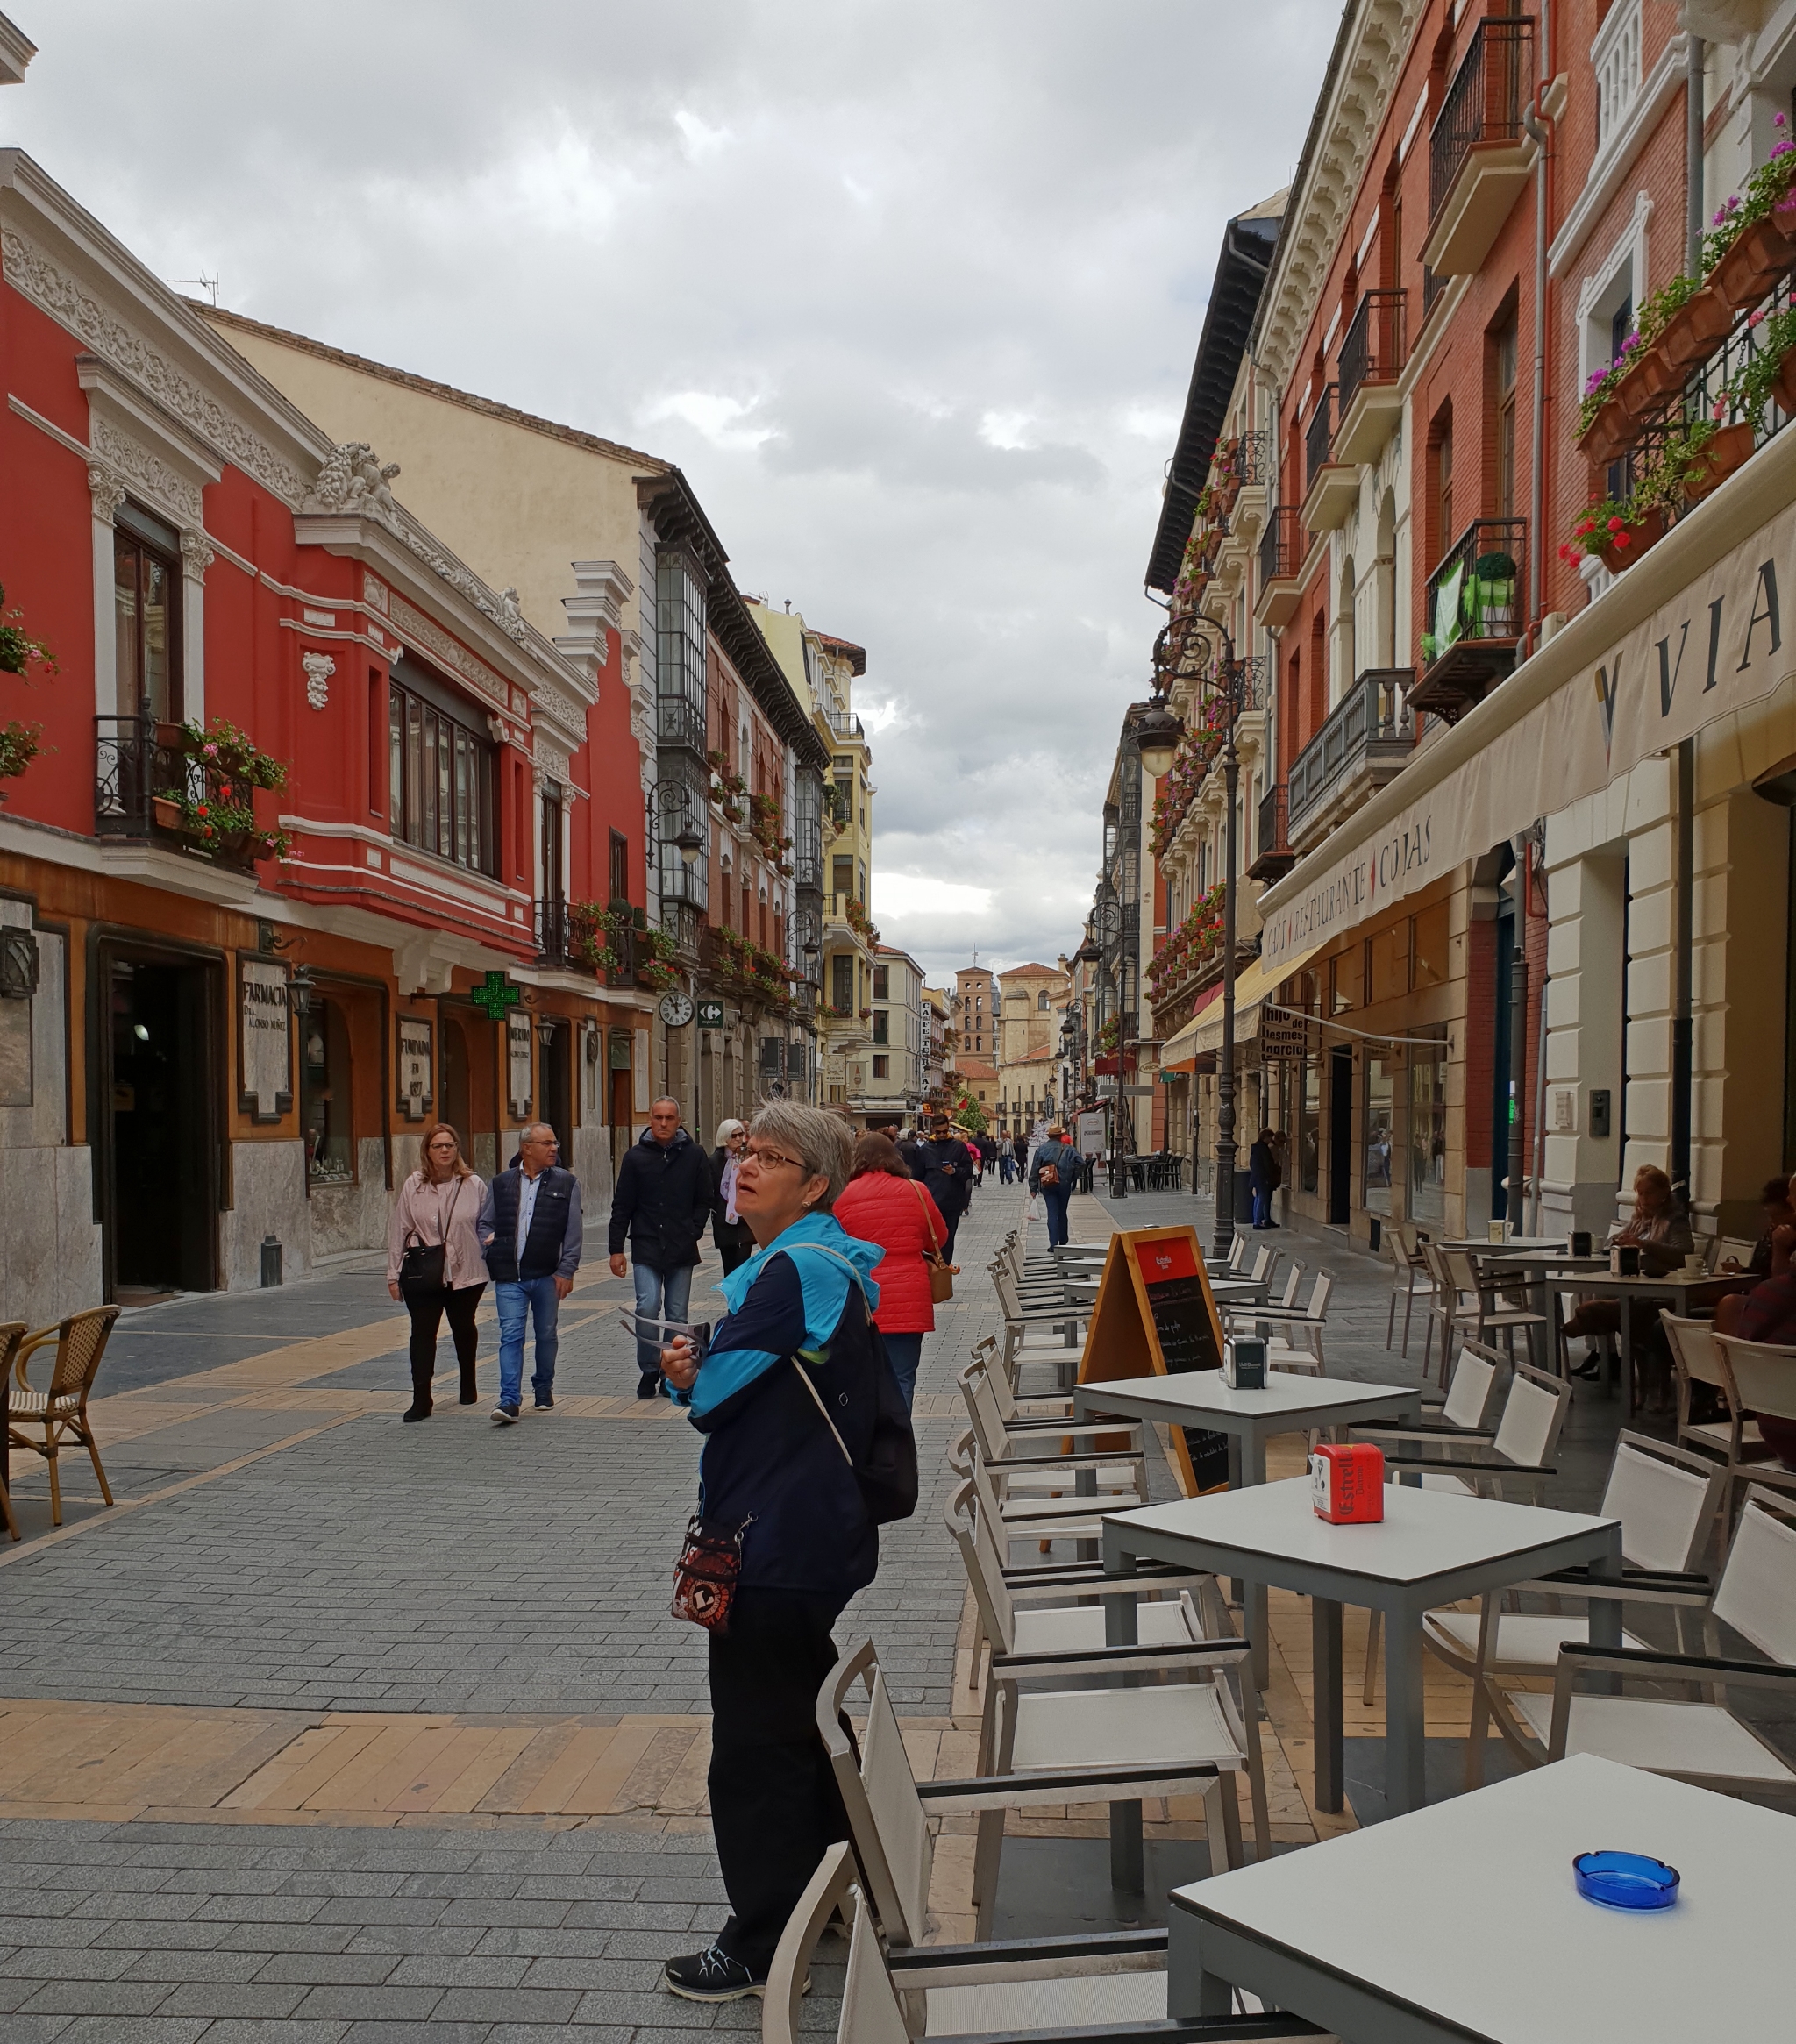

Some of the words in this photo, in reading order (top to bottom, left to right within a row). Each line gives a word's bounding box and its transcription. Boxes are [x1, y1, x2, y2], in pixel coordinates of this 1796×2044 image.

[243, 981, 287, 1008] FARMACIA
[1292, 1019, 1303, 1029] de
[1266, 1029, 1303, 1041] lesmes
[1338, 1449, 1354, 1515] Estrella
